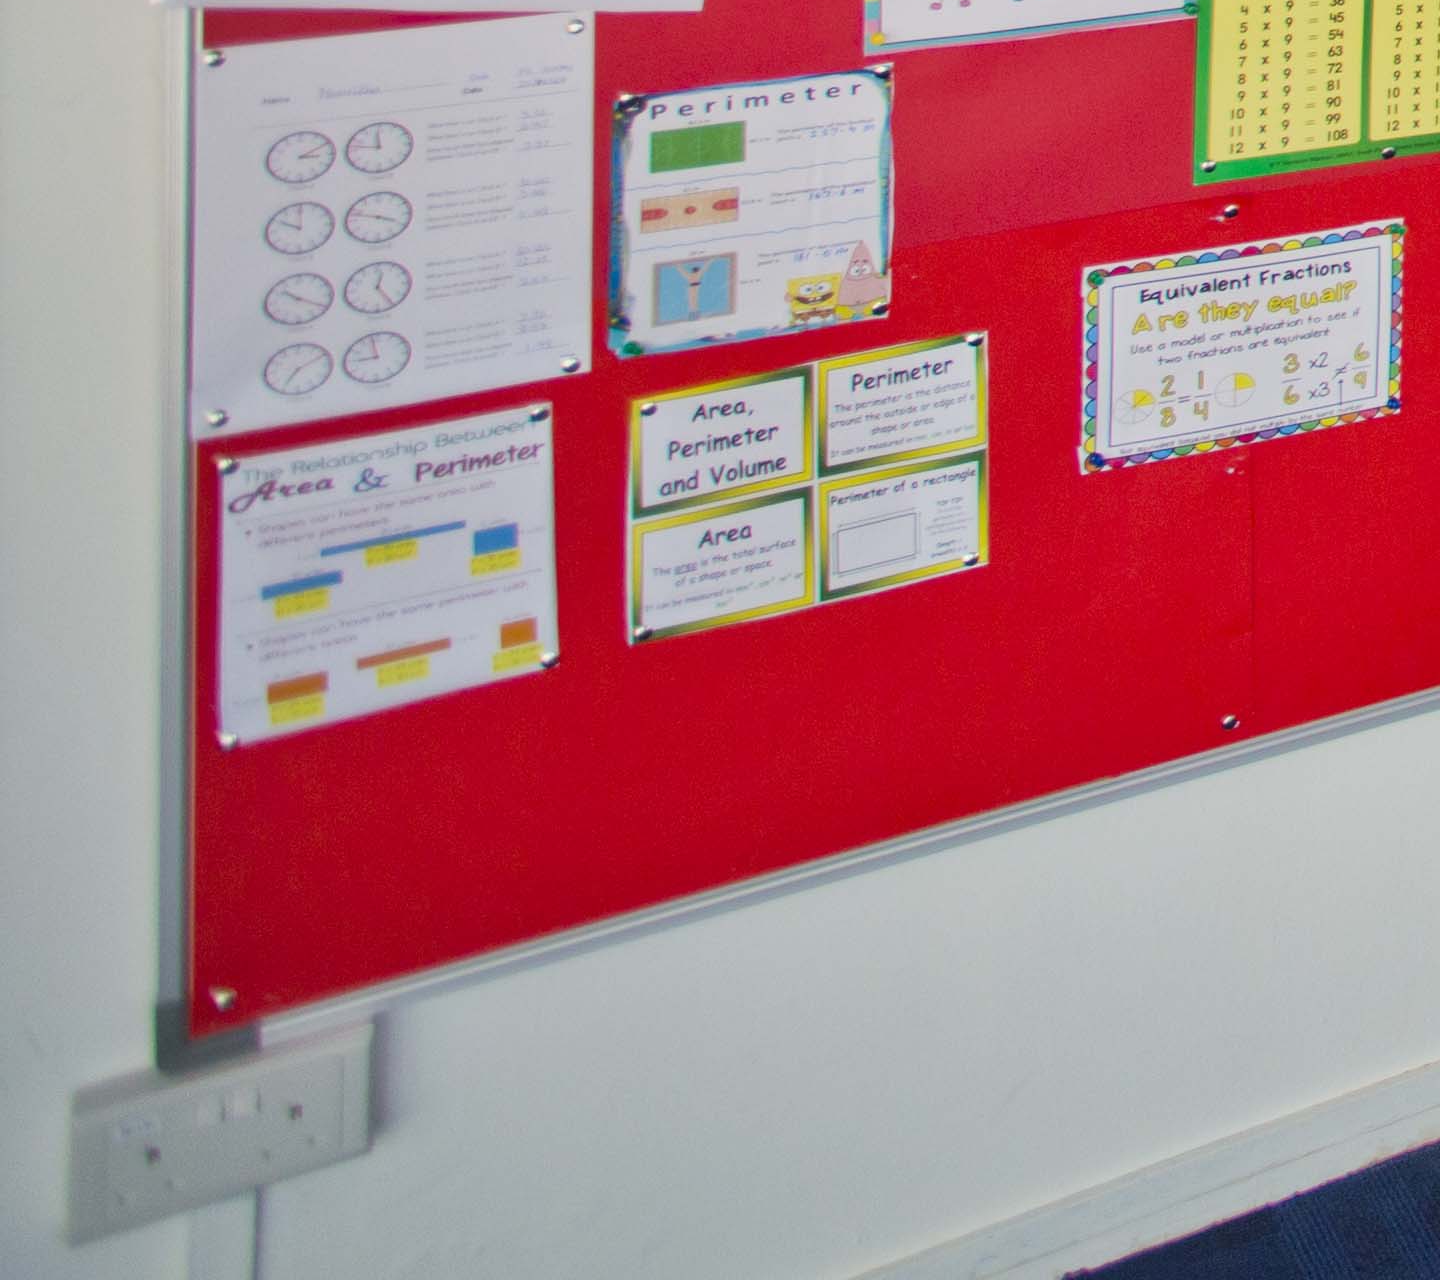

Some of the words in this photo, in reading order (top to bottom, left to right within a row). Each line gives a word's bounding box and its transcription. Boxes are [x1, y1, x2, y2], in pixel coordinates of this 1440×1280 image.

[651, 82, 862, 120] Perimeter
[1140, 276, 1252, 305] Equivalent
[1259, 261, 1352, 286] Fractions
[1131, 310, 1189, 335] Are
[1200, 300, 1260, 327] they
[1268, 280, 1357, 312] equal?
[851, 358, 953, 392] Perimeter
[691, 399, 754, 422] Area,
[668, 424, 779, 461] Perimeter
[228, 476, 334, 514] Area
[353, 468, 390, 493] &
[415, 442, 546, 483] Perimeter
[660, 474, 698, 498] and
[710, 456, 787, 486] Volume
[830, 484, 888, 508] Perimeter
[893, 480, 907, 494] of
[911, 481, 918, 490] a
[922, 467, 976, 486] rectangle
[698, 523, 752, 549] Area
